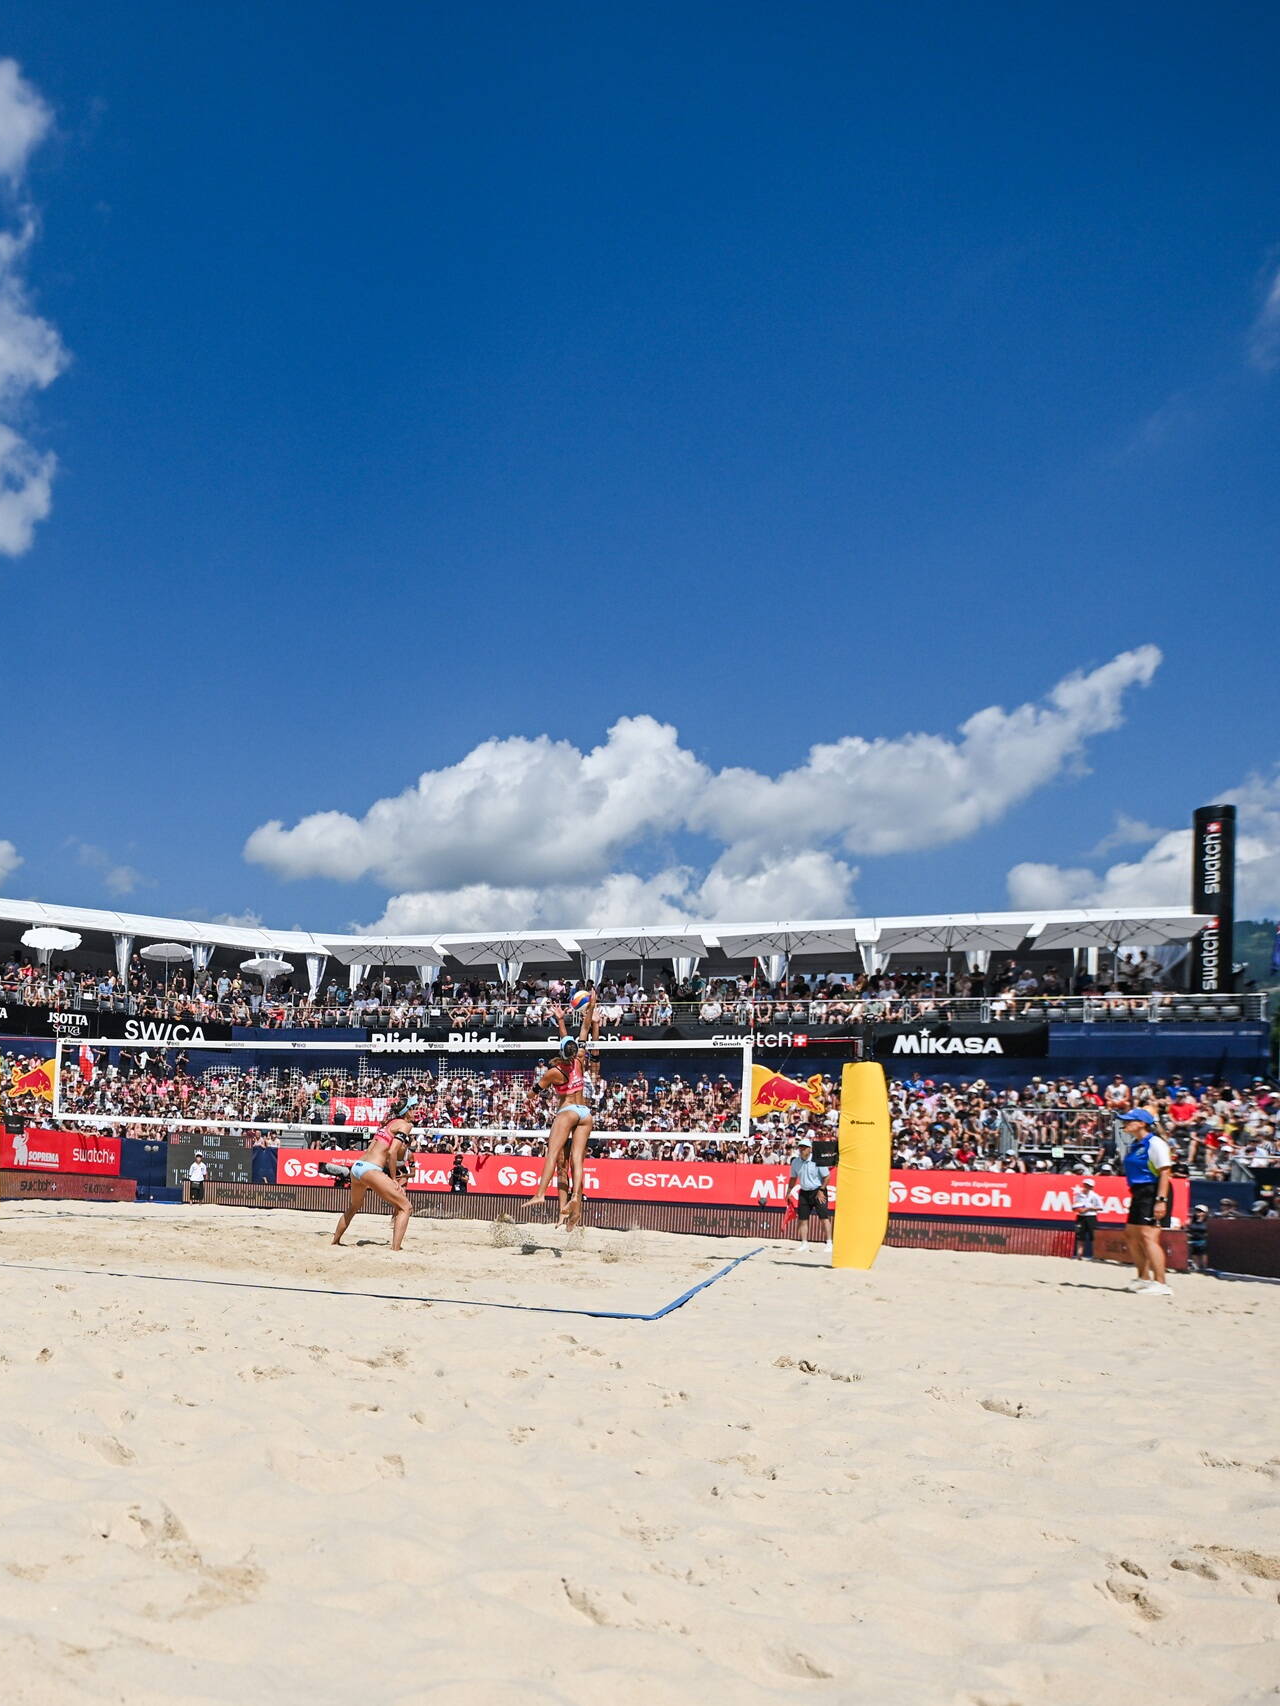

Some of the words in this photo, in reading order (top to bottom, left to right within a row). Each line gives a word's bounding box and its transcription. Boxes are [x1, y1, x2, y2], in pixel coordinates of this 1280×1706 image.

[1203, 832, 1222, 894] swatch
[1201, 928, 1219, 990] swatch
[124, 1020, 206, 1041] SWICA
[371, 1032, 425, 1053] Blick
[448, 1032, 505, 1053] Blick
[28, 1151, 60, 1163] SOPREMA
[72, 1148, 109, 1163] swatch
[627, 1173, 714, 1190] GSTAAD
[910, 1185, 1013, 1208] Senoh
